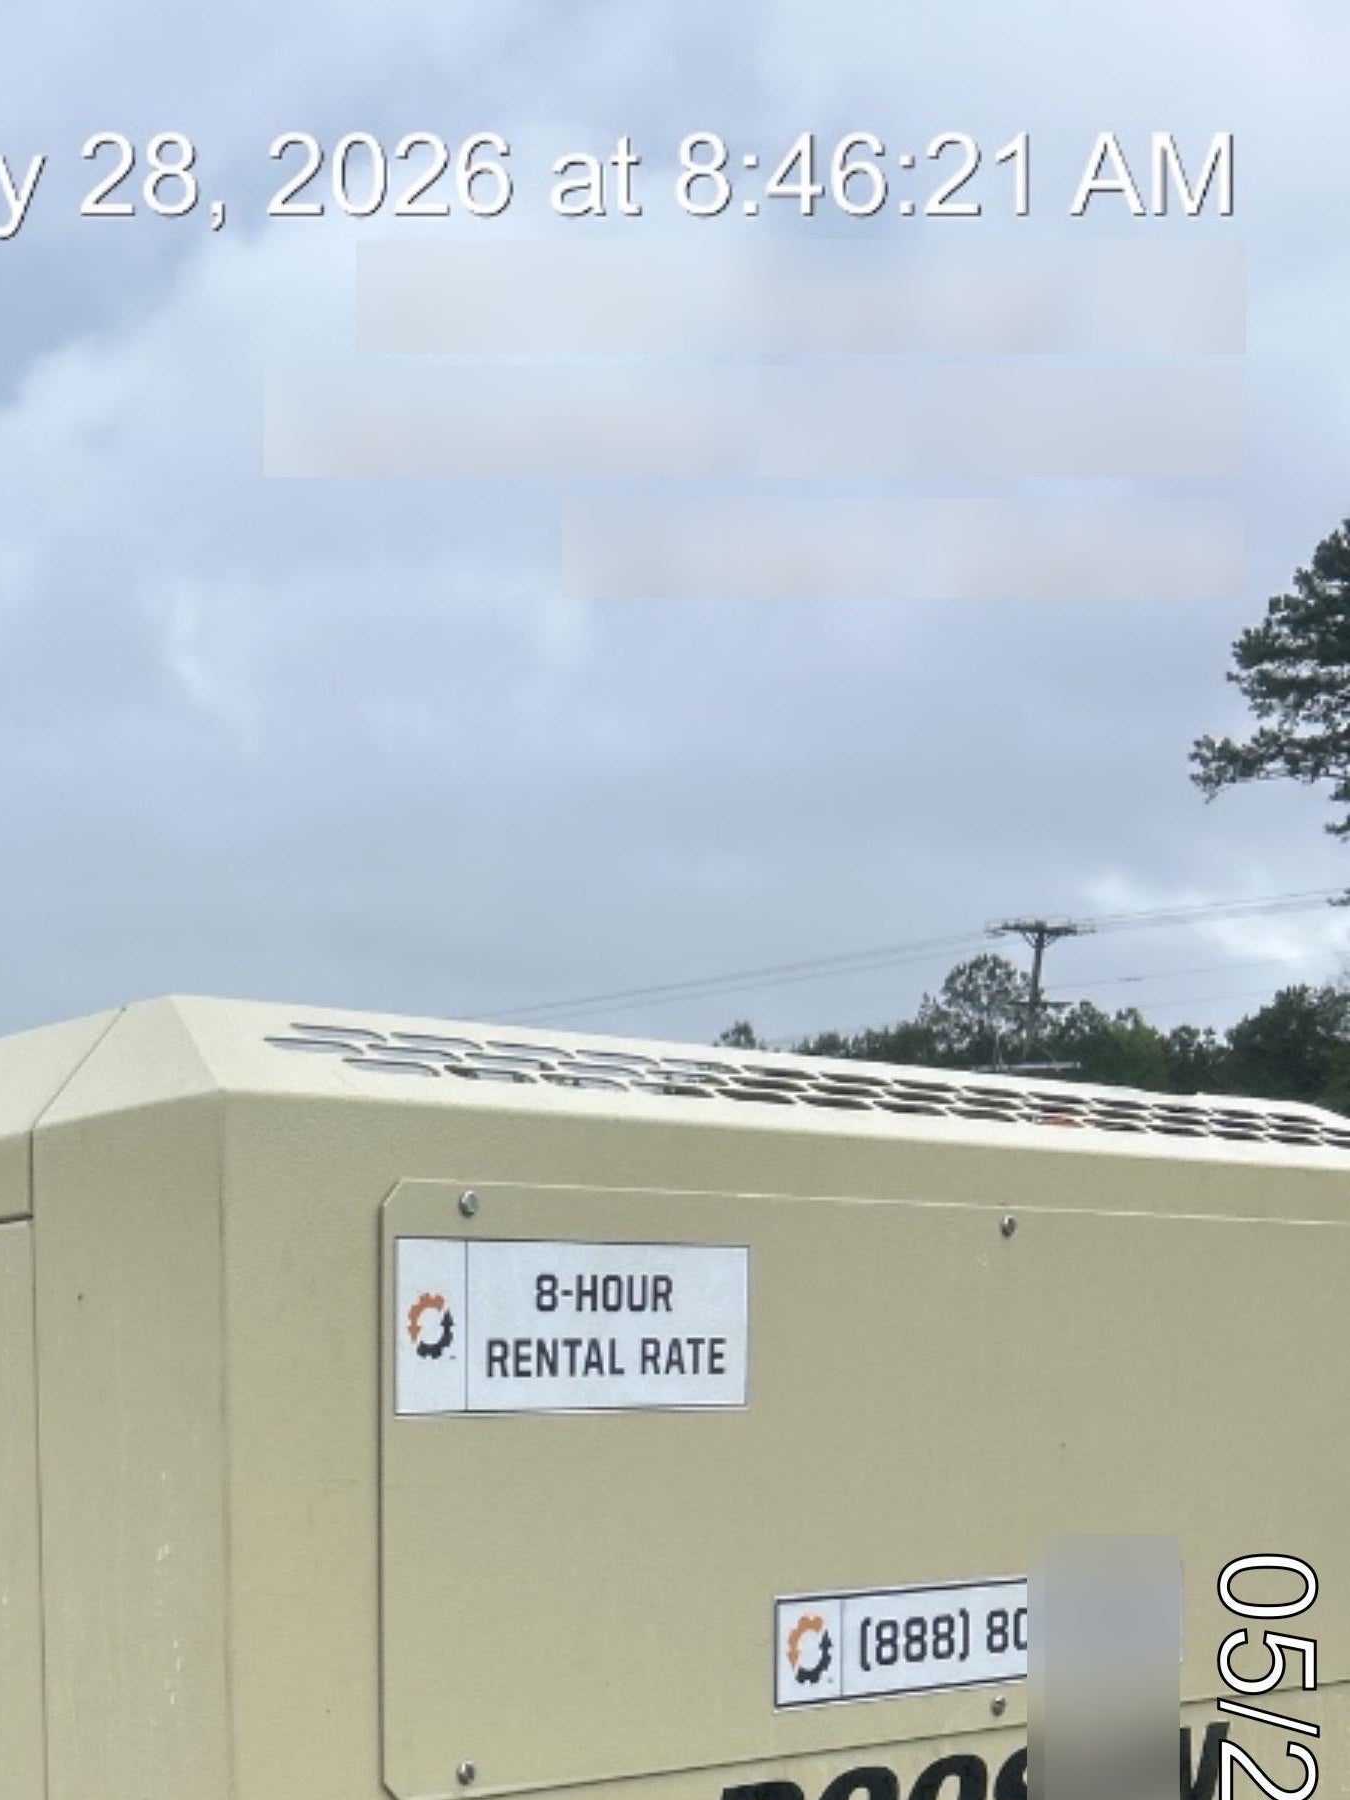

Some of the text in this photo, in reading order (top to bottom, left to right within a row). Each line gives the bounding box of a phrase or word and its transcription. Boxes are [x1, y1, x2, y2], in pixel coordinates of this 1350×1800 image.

[534, 1274, 673, 1312] 8-HOUR
[486, 1337, 727, 1378] RENTAL RATE
[860, 1607, 970, 1672] (888)
